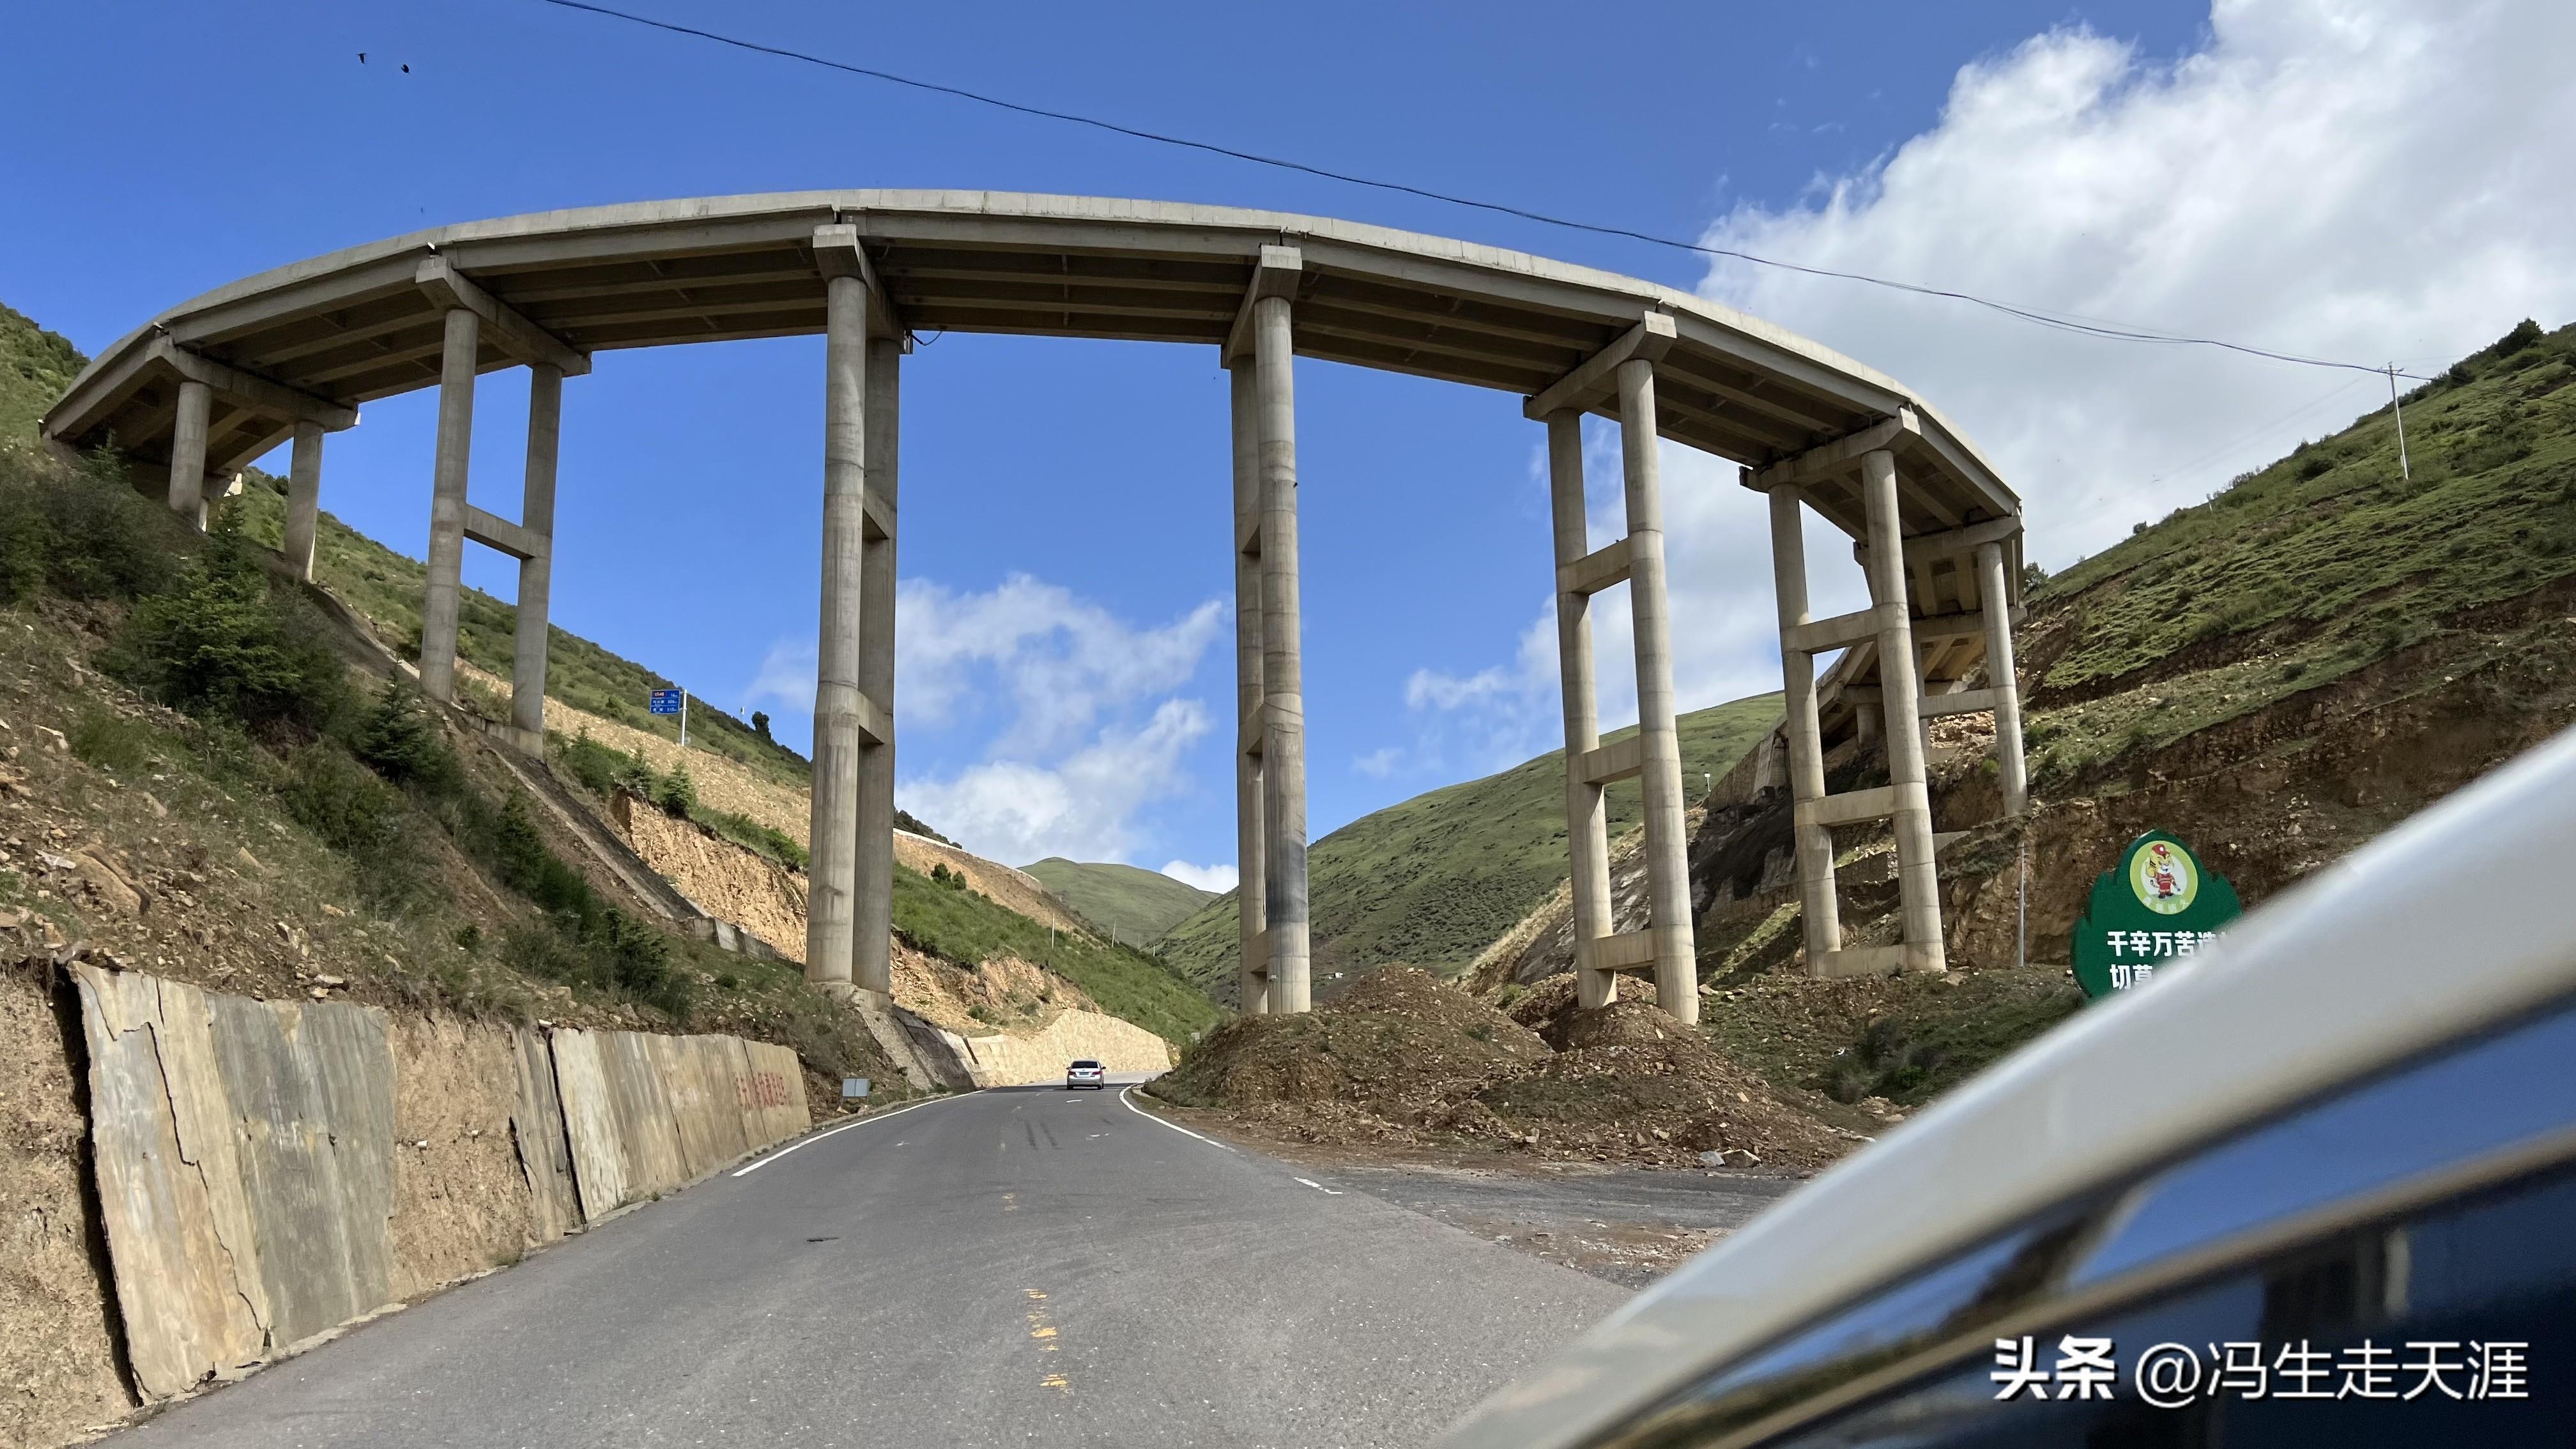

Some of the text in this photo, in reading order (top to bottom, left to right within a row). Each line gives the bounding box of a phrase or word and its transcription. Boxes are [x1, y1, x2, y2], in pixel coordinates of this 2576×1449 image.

[2107, 930, 2227, 957] 千辛万苦造
